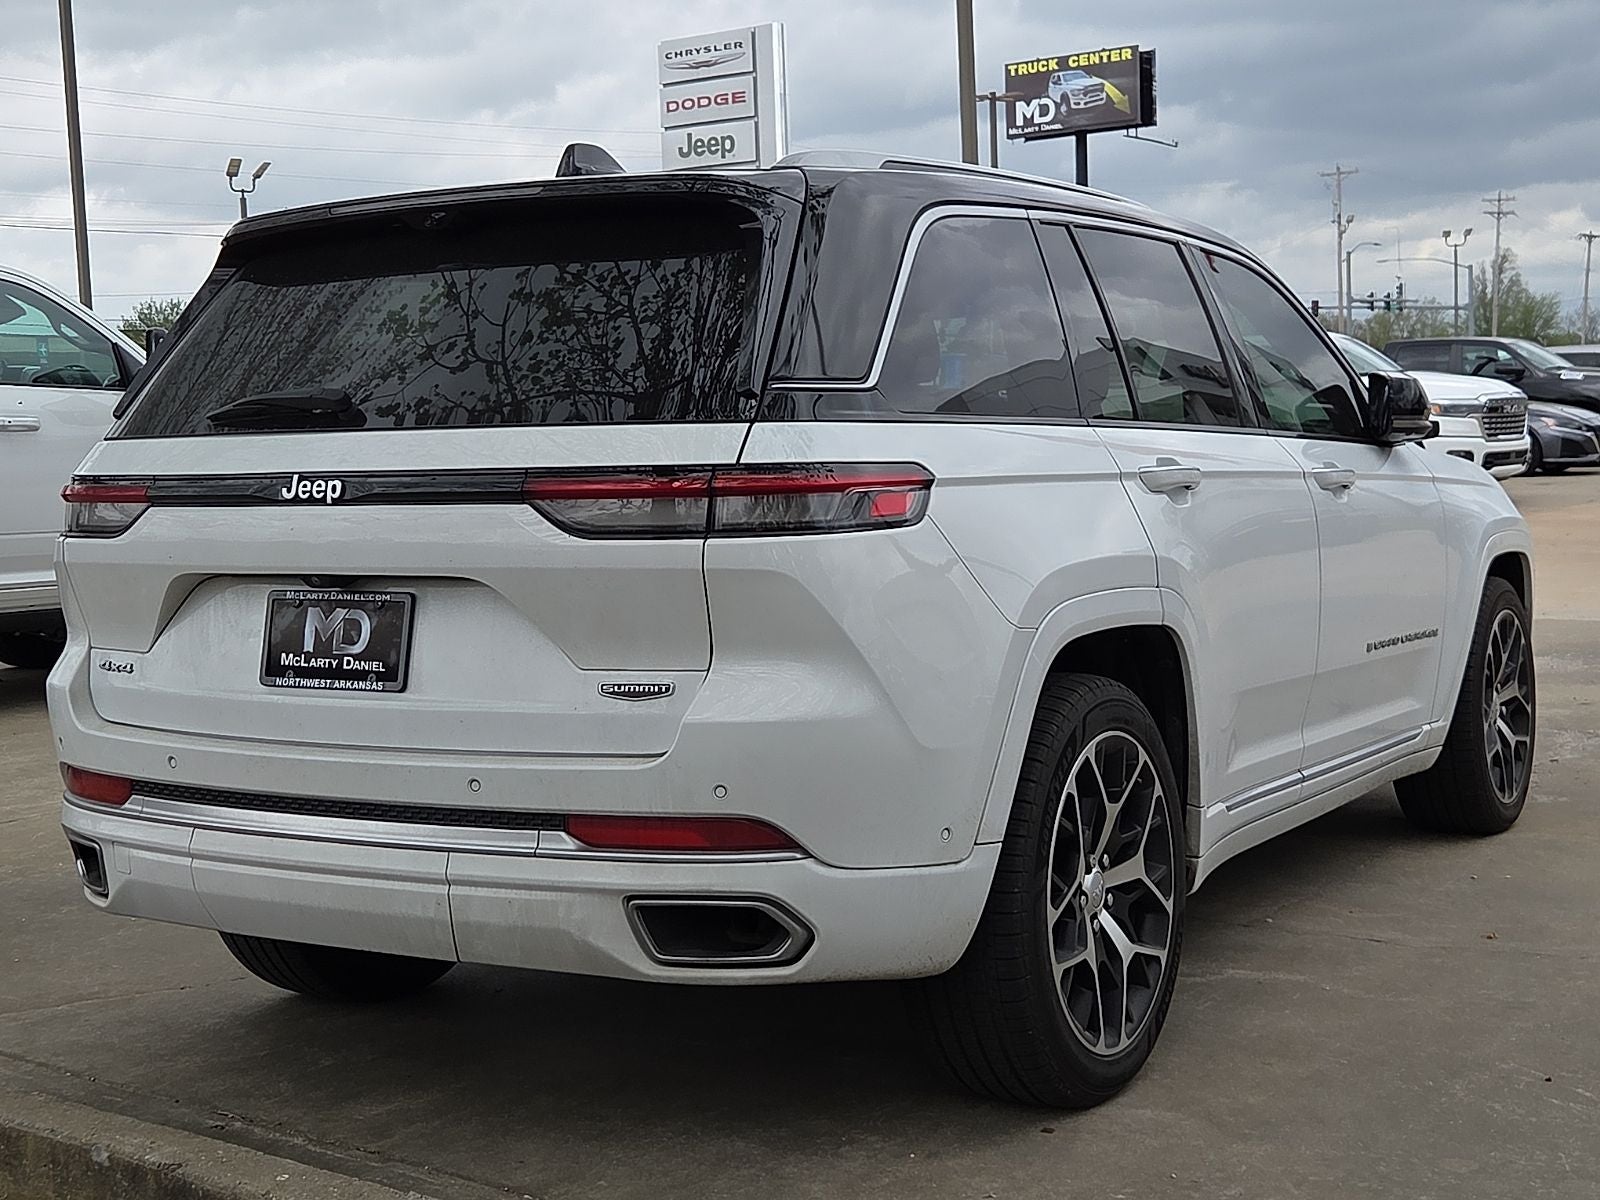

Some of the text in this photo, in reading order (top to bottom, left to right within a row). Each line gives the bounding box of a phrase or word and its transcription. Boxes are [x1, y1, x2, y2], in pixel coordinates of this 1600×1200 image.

[665, 41, 744, 60] CHRYSLER
[1008, 48, 1133, 77] TRUCK CENTER
[666, 90, 747, 114] DODGE
[678, 132, 736, 159] Jeep
[281, 474, 342, 504] Jeep
[303, 606, 371, 655] MD
[343, 656, 386, 672] DANIEL
[275, 677, 384, 690] NORTHWEST ARKANSAS
